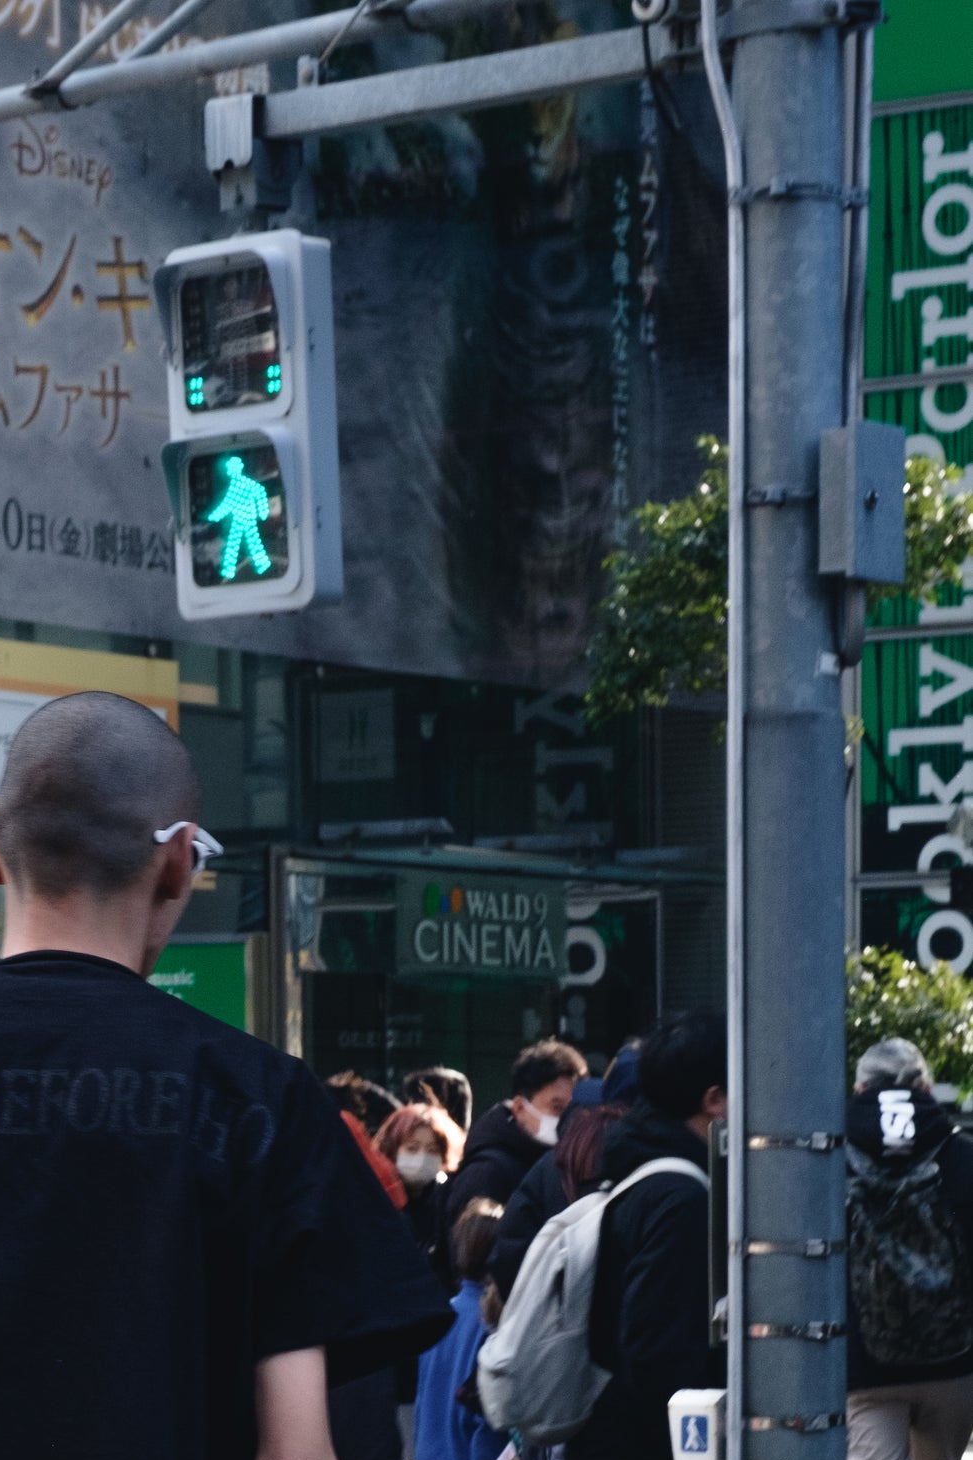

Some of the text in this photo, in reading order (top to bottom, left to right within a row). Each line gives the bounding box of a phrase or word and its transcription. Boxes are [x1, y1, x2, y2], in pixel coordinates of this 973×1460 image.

[466, 890, 549, 927] WALD 9
[414, 919, 556, 969] CINEMA
